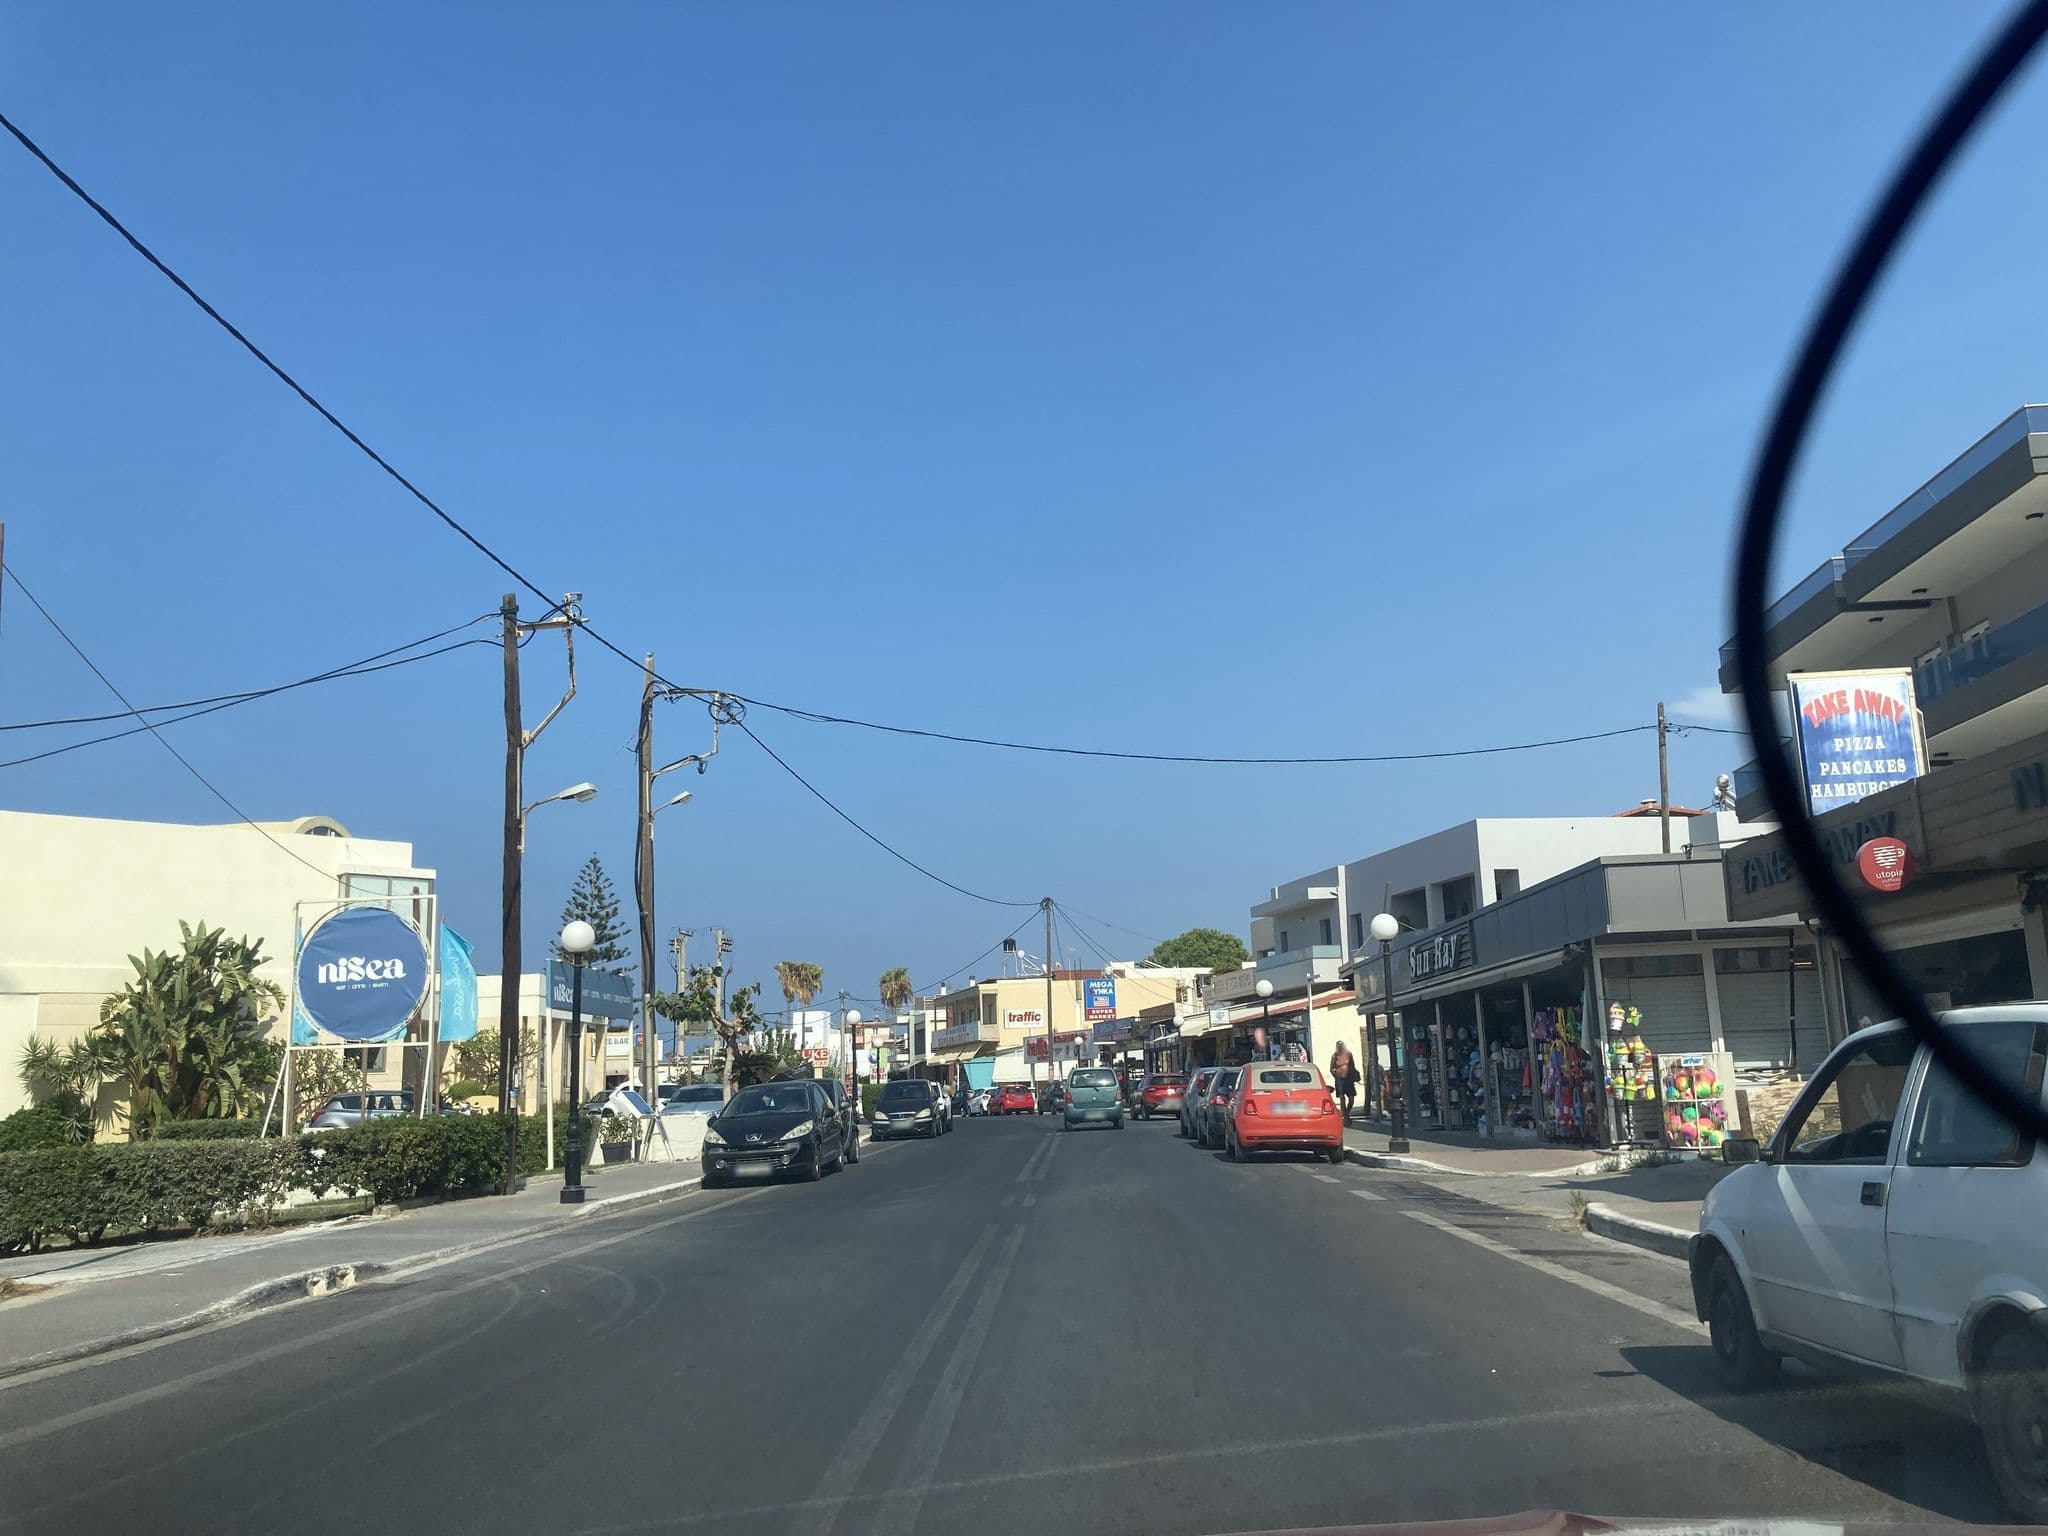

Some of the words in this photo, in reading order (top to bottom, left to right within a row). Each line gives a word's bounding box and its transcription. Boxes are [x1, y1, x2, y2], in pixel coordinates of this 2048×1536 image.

[1803, 690, 1850, 728] TAKE
[1854, 689, 1905, 725] AWAY
[1833, 736, 1886, 752] PIZZA
[1819, 759, 1907, 776] PANCAKES
[1410, 946, 1430, 977] Sun
[1434, 934, 1457, 970] Ray
[1089, 981, 1114, 989] MEGA
[1008, 1011, 1041, 1023] traffic
[614, 1037, 630, 1045] BAR
